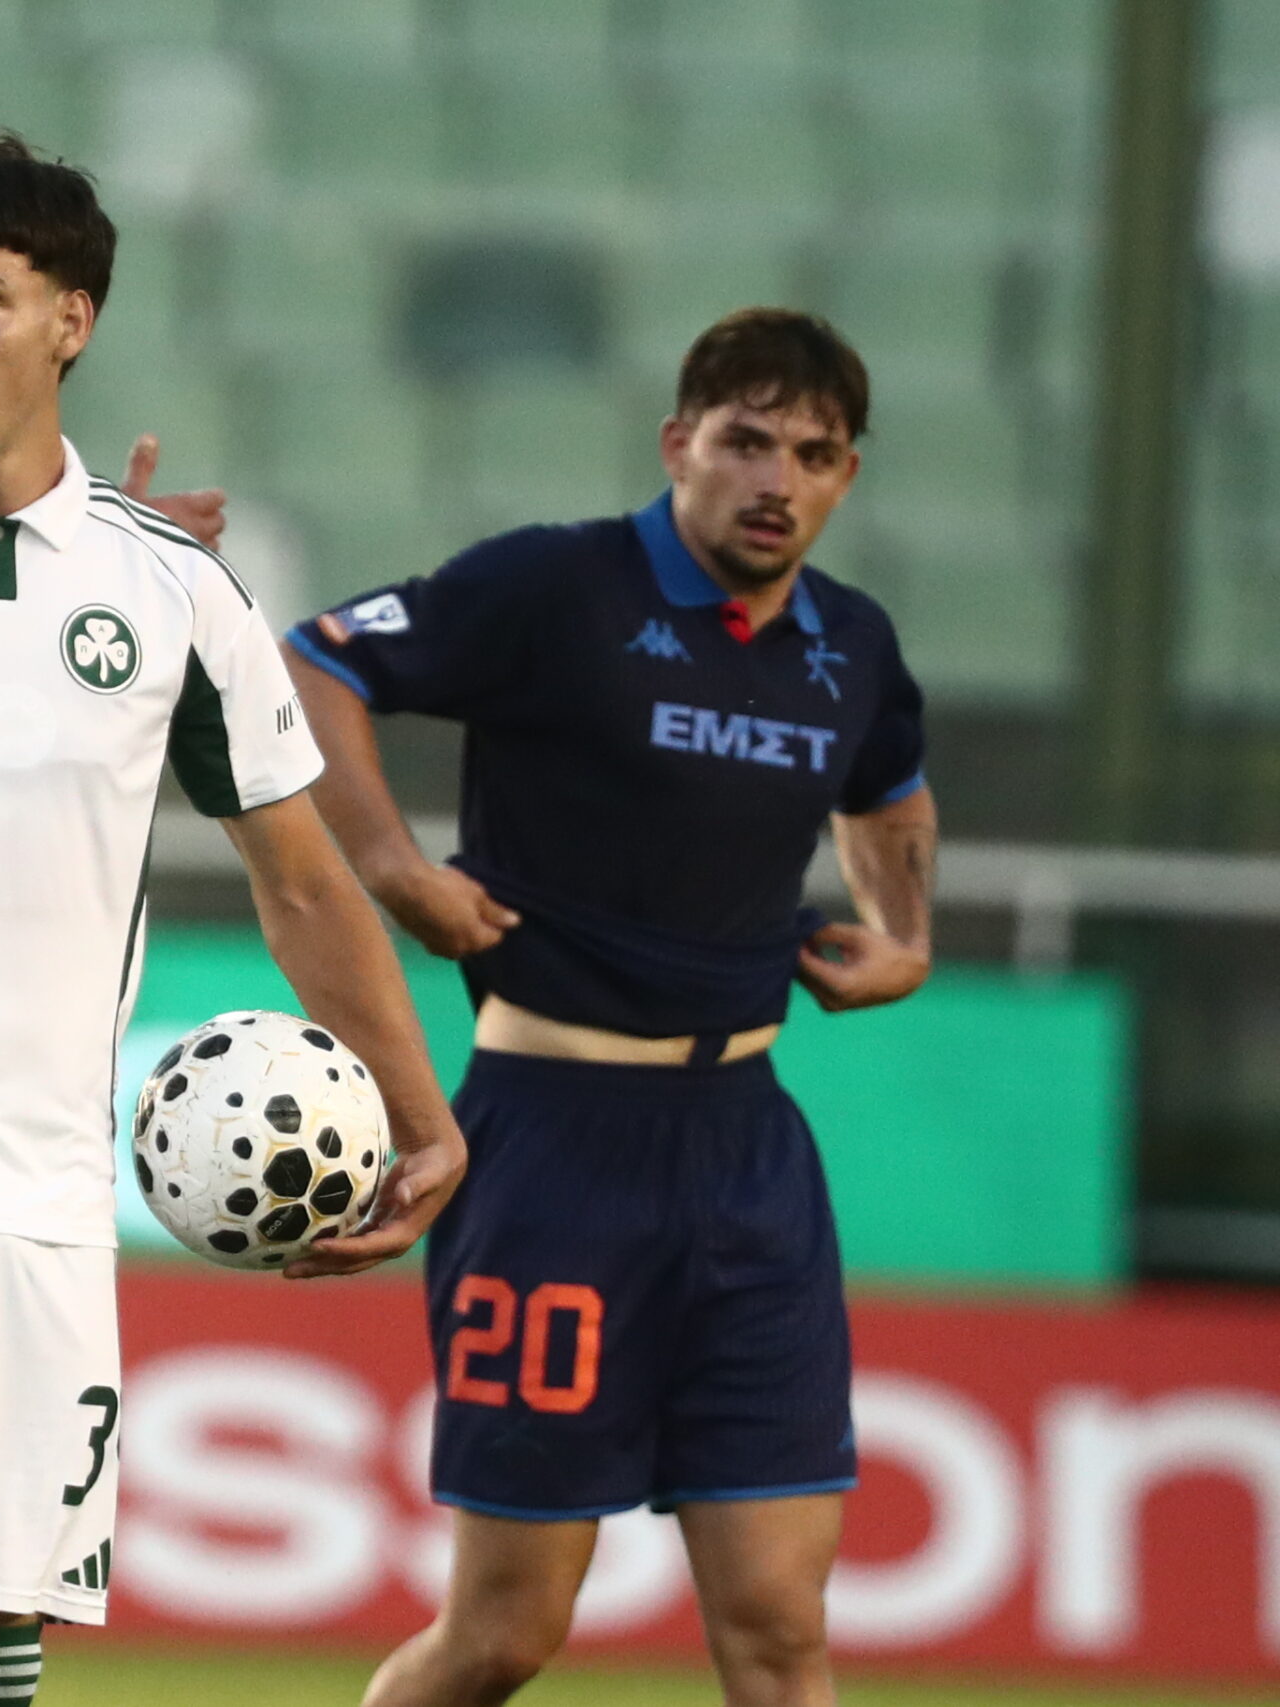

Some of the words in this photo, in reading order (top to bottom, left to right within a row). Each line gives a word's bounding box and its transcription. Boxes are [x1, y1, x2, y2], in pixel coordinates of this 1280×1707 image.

[650, 701, 838, 773] ΕΜΣΤ
[446, 1275, 604, 1414] 20
[61, 1384, 120, 1507] 3
